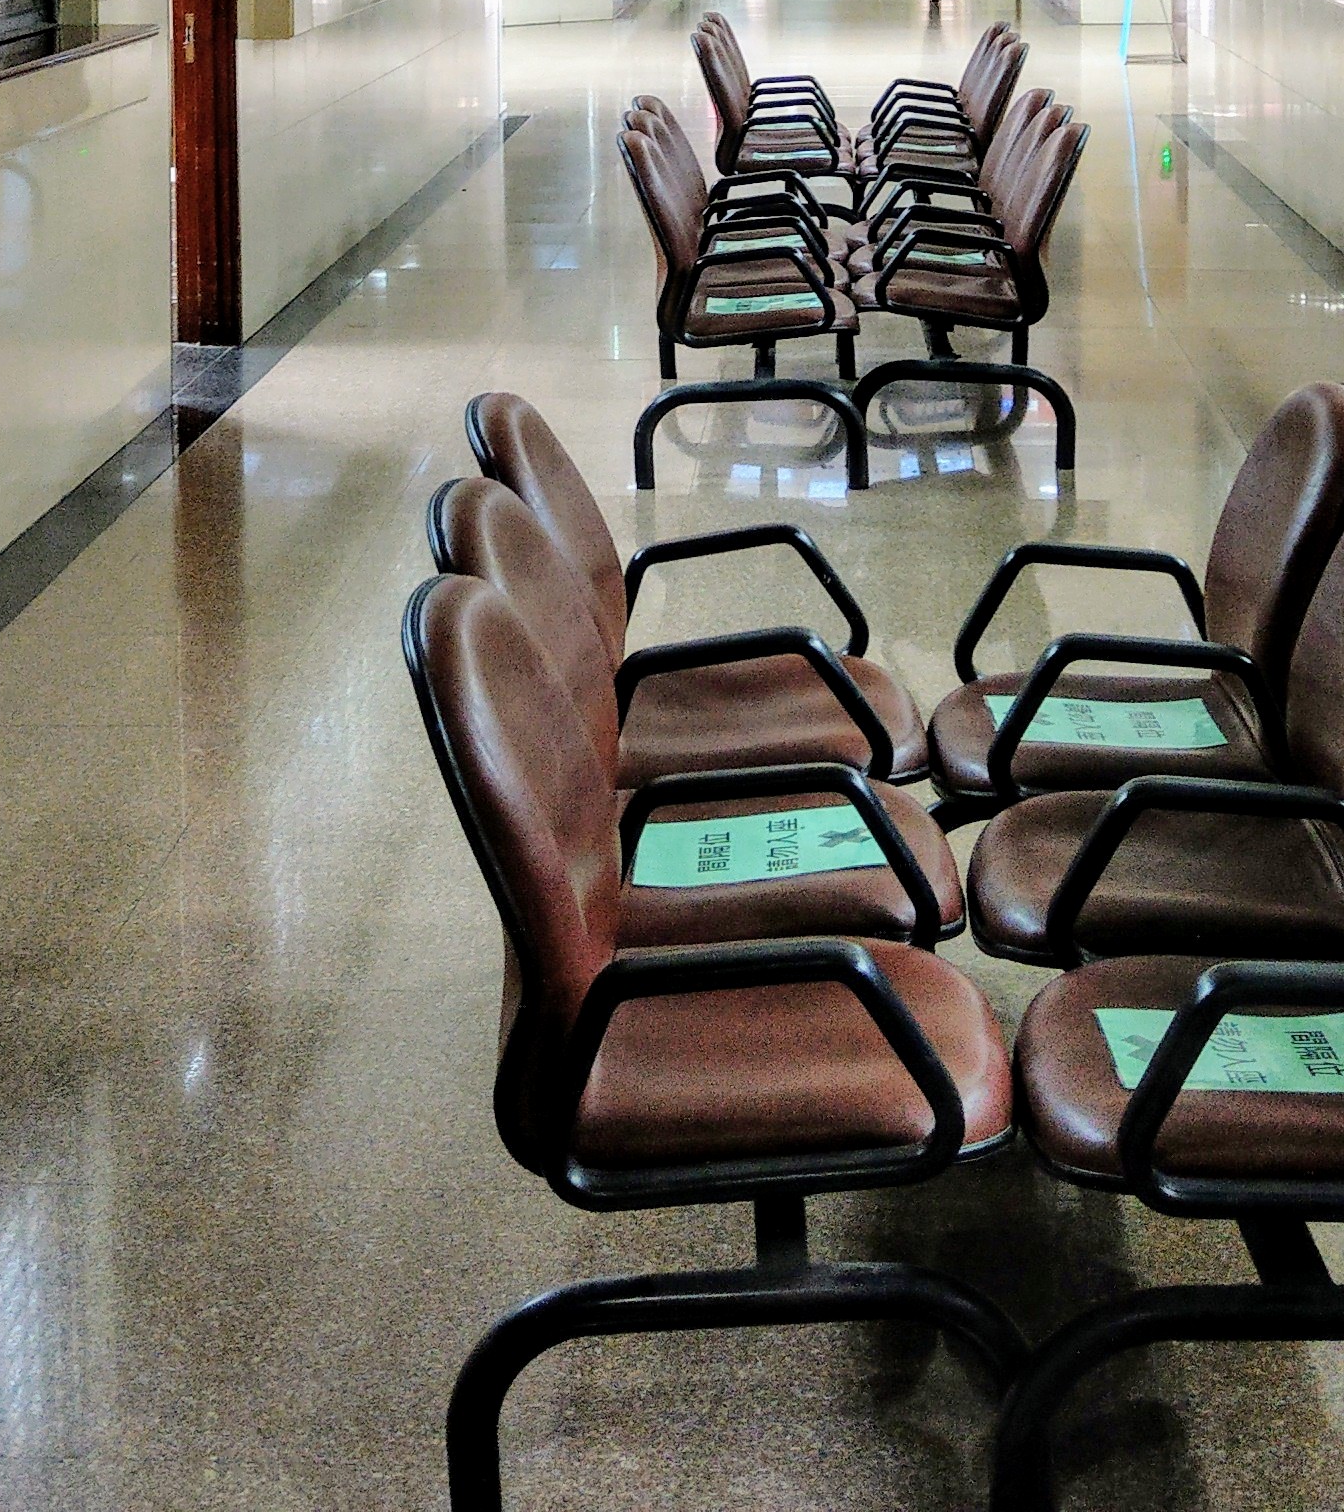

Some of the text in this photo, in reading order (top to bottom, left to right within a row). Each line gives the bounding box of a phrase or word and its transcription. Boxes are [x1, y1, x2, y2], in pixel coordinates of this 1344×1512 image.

[697, 831, 731, 873] 間隔位
[766, 817, 799, 873] 請勿入座
